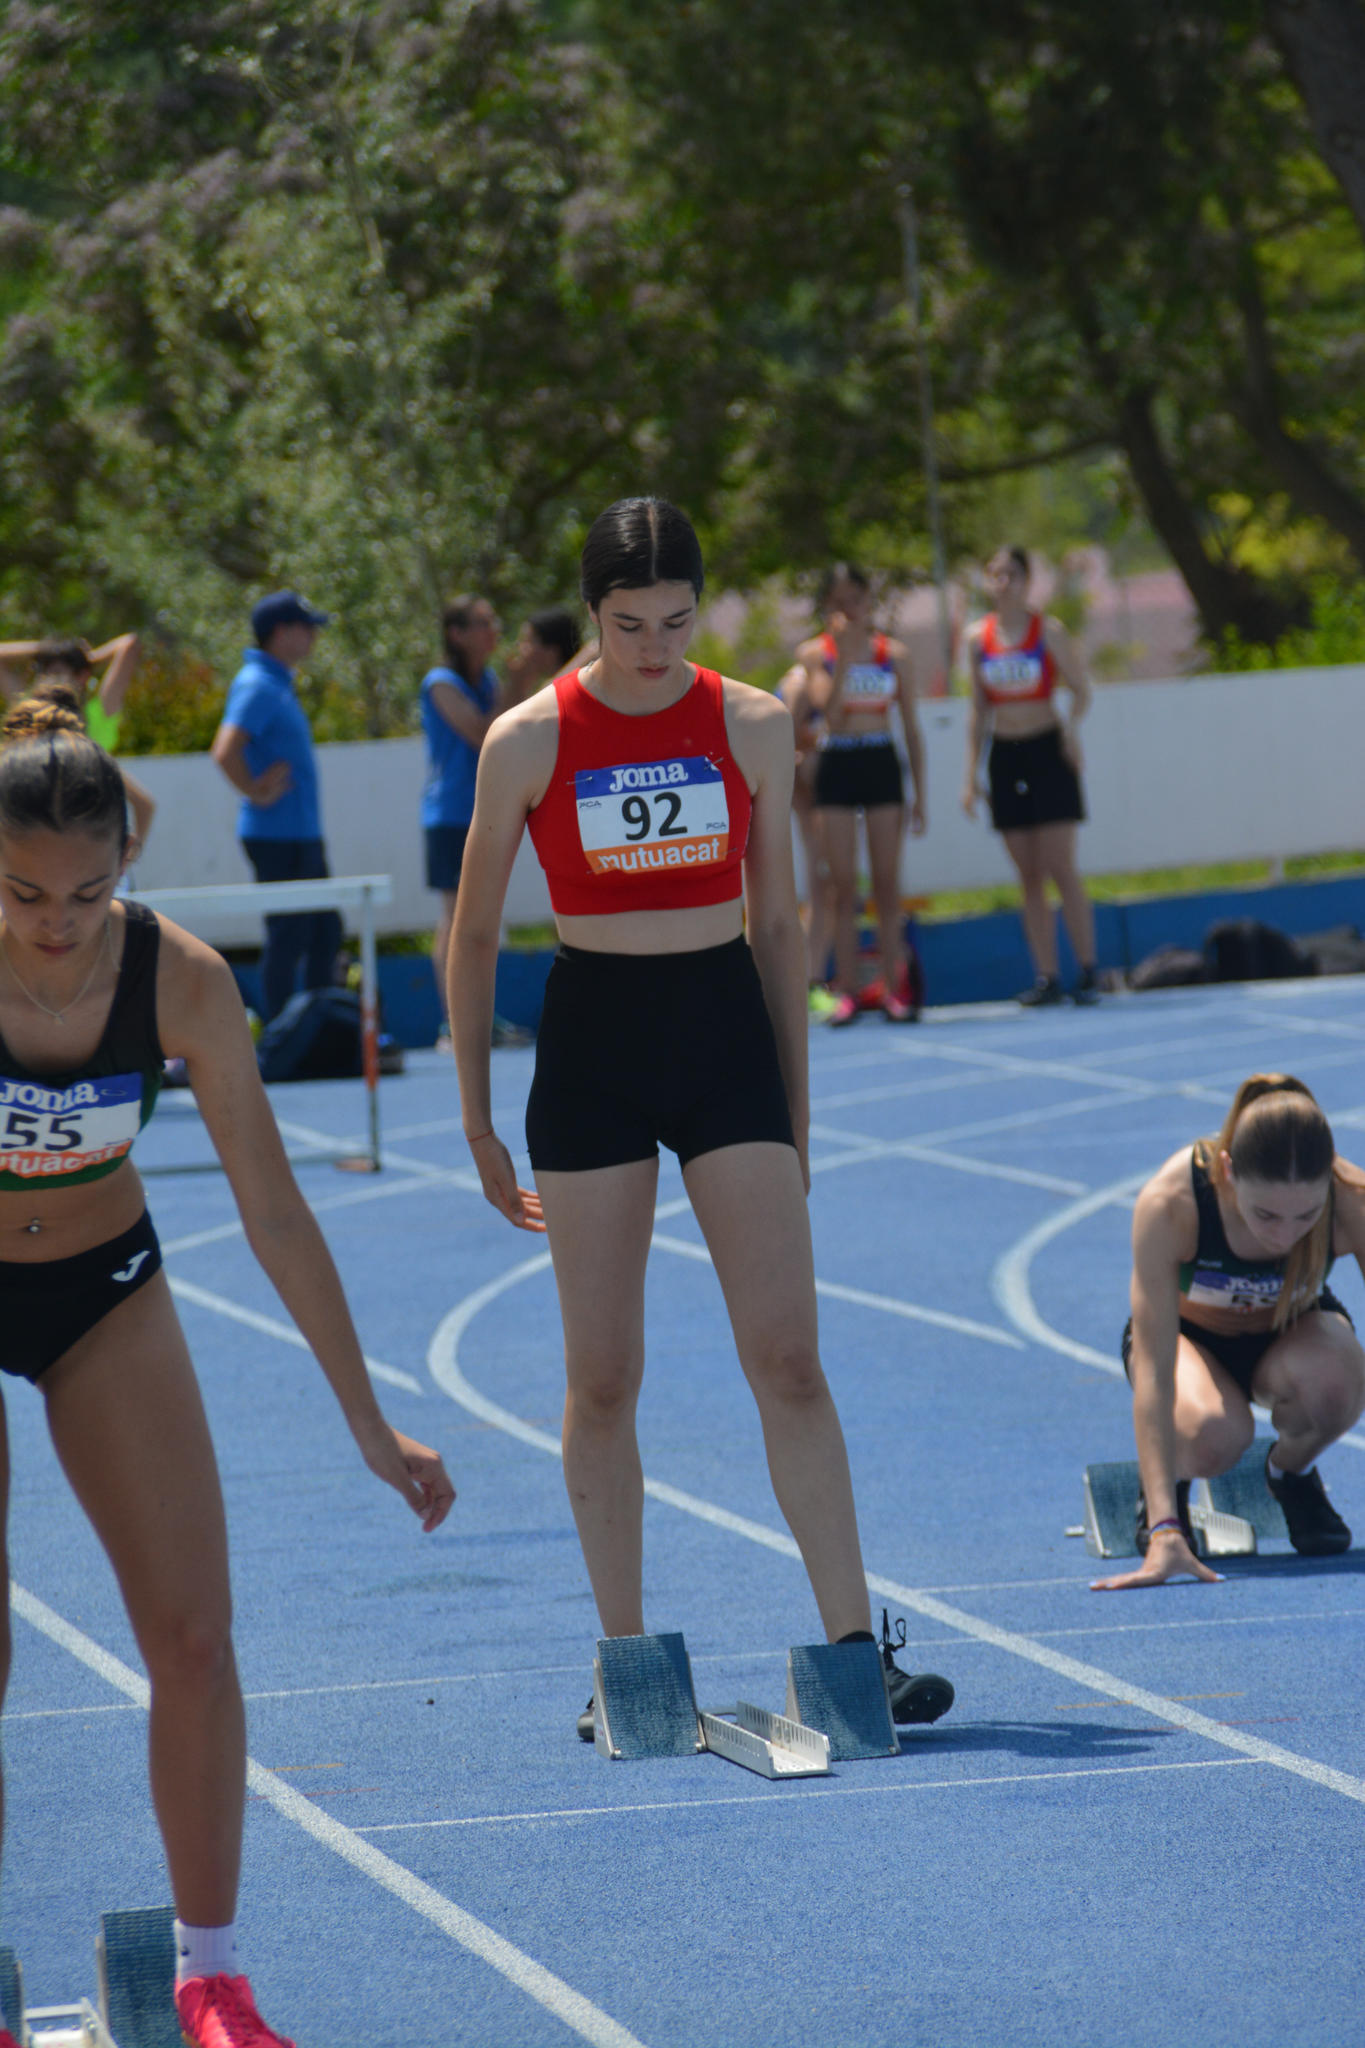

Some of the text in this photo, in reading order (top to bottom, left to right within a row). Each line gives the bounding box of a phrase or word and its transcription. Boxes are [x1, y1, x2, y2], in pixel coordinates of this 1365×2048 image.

[621, 791, 688, 841] 92
[598, 837, 720, 871] mutuacat
[1, 1112, 82, 1152] 55
